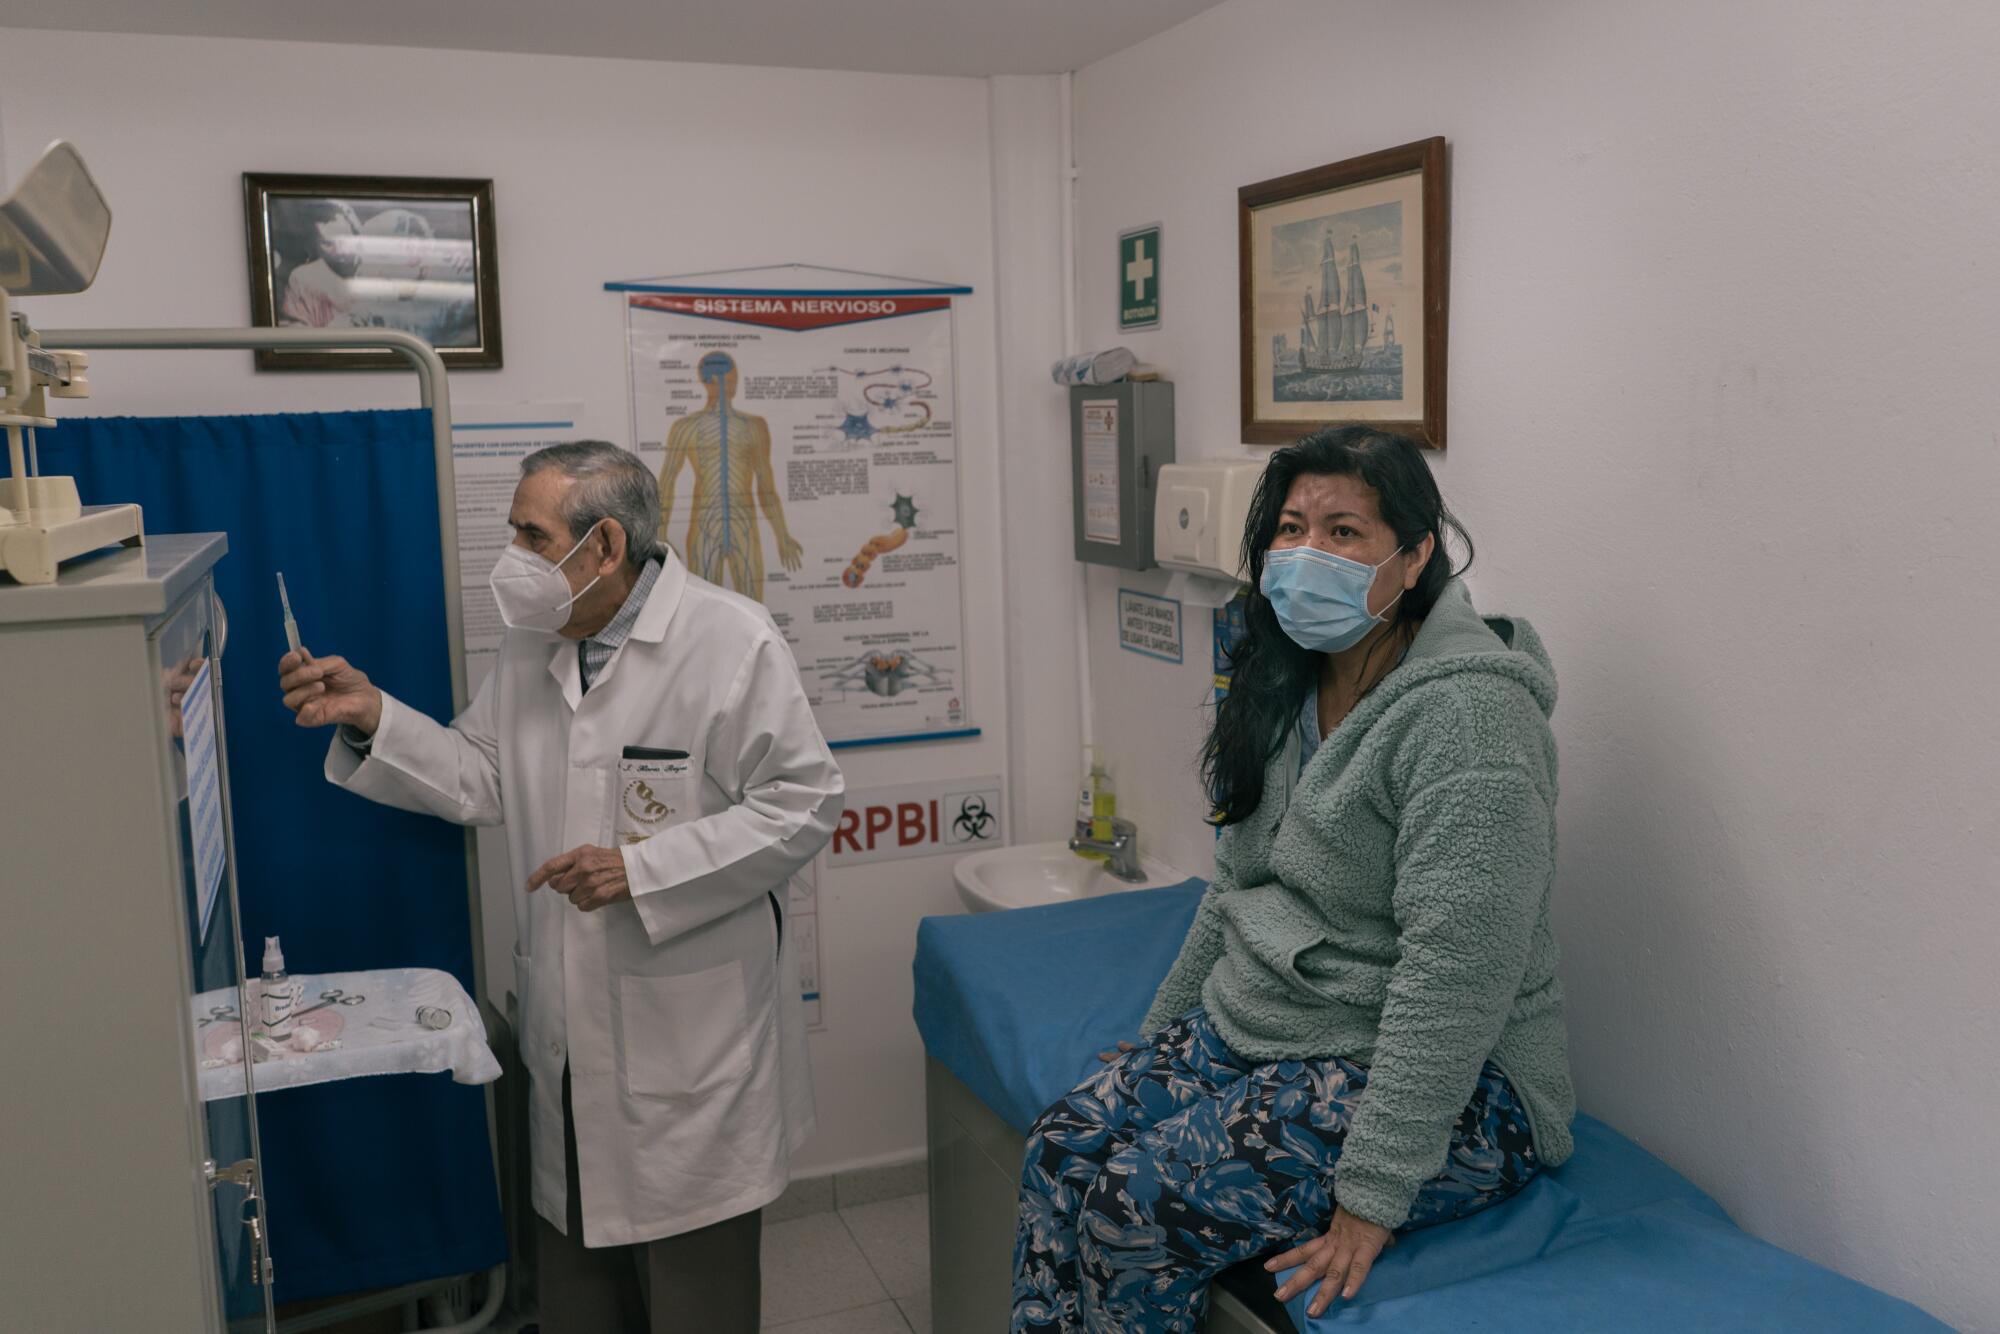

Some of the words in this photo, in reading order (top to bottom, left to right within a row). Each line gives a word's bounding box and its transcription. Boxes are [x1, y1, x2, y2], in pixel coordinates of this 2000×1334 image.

[693, 300, 786, 314] SISTEMA
[791, 300, 897, 314] NERVIOSO
[832, 799, 940, 854] RPBI
